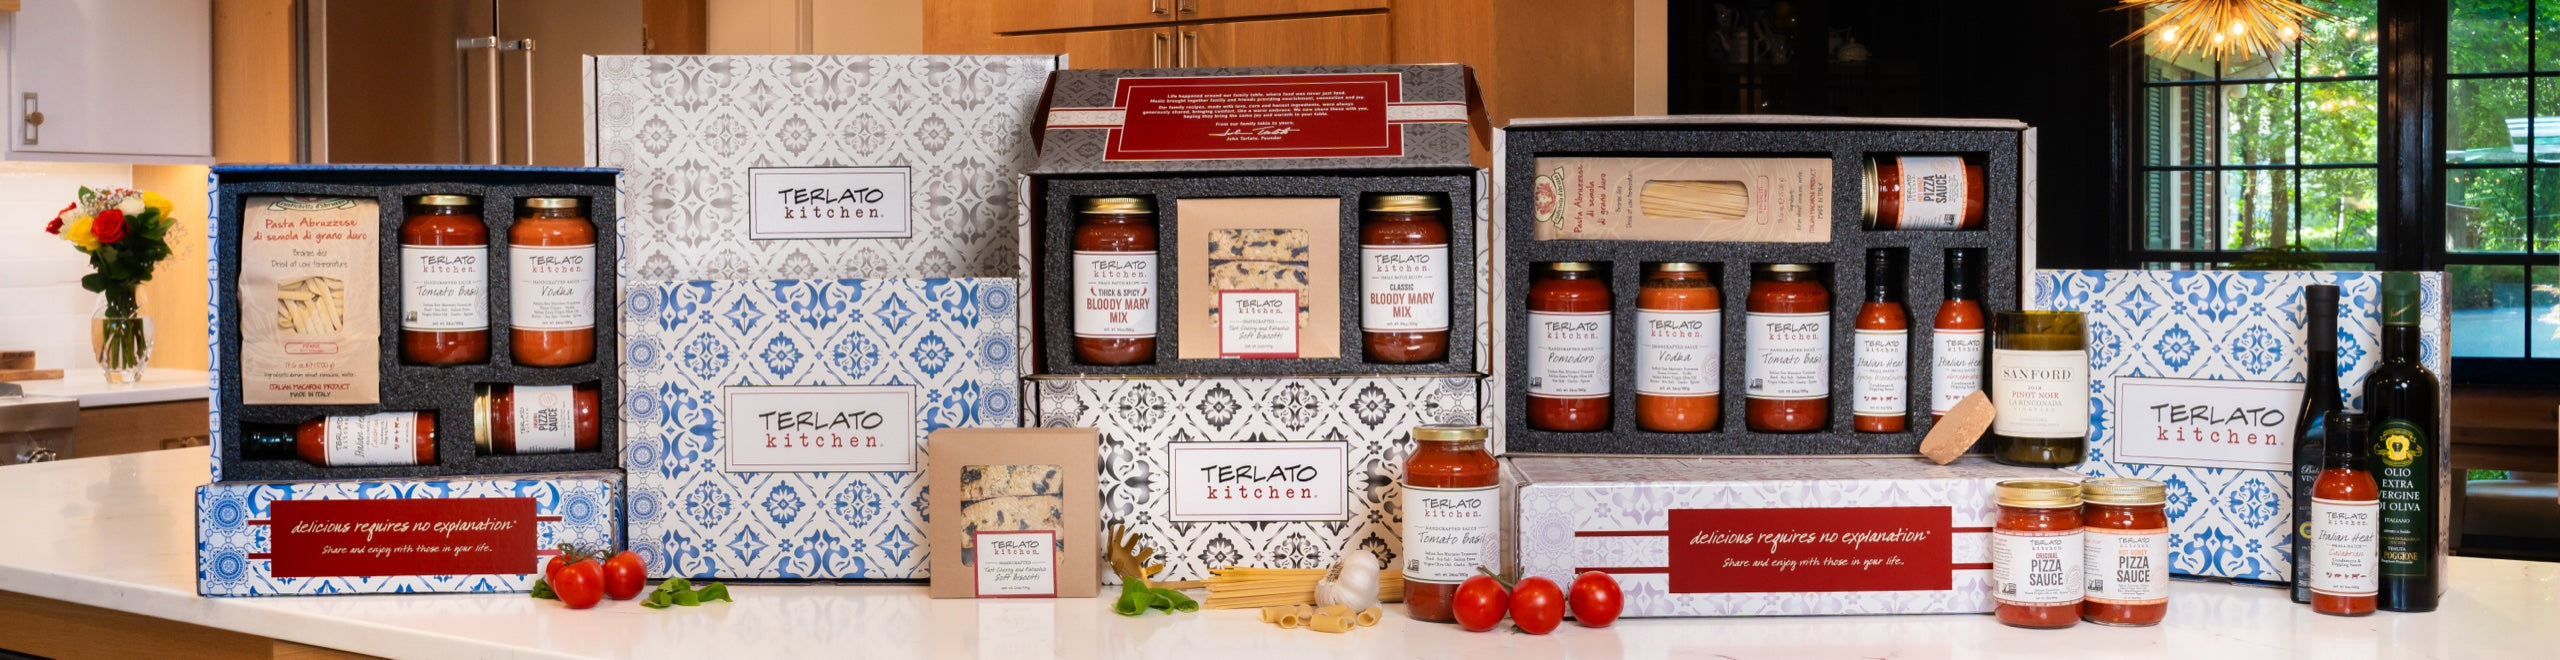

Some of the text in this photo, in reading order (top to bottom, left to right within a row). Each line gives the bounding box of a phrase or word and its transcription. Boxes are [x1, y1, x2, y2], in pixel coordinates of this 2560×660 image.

[1597, 173, 1606, 190] duro
[1586, 181, 1594, 207] semola
[1923, 175, 1935, 202] PIZZA
[1936, 174, 1947, 204] SAUCE
[778, 187, 884, 205] TERLATO
[1574, 164, 1583, 233] Pasta Abruzzese
[1598, 194, 1608, 215] grano
[265, 217, 357, 229] Pasta Abruzzese
[253, 229, 367, 243] di semola di grano duro
[420, 256, 476, 265] TERLATO
[529, 256, 583, 265] TERLATO
[1091, 260, 1146, 270] TERLATO
[1374, 254, 1430, 264] TERLATO
[416, 285, 480, 296] Tomato Basil
[541, 285, 574, 297] Vodka
[1098, 288, 1115, 296] THICK
[1123, 288, 1140, 297] SPICY
[1087, 298, 1150, 310] BLOODY MARY
[1236, 299, 1283, 308] TERLATO
[1370, 292, 1434, 305] BLOODY MARY
[1110, 312, 1128, 324] MIX
[1393, 306, 1412, 318] MIX
[1545, 321, 1598, 332] TERLATO
[1649, 319, 1702, 330] TERLATO
[1767, 323, 1819, 333] TERLATO
[1239, 332, 1254, 340] Soft
[1548, 352, 1595, 364] Pomodoro
[1659, 351, 1692, 362] Vodka
[1762, 353, 1800, 364] Tomato
[1857, 357, 1904, 367] Italian Heat
[1938, 357, 1983, 367] Italian Hea
[2003, 369, 2071, 380] SANFORD
[2012, 390, 2036, 398] PINOT
[538, 409, 547, 430] PIZZA
[549, 408, 558, 432] SAUCE
[759, 410, 883, 431] TERLATO
[2150, 403, 2284, 427] TERLATO
[1201, 464, 1317, 484] TERLATO
[2384, 467, 2411, 477] OLIO
[2382, 479, 2414, 489] EXTRA
[1422, 498, 1481, 509] TERLATO
[2389, 502, 2420, 512] OLIVA
[2326, 512, 2368, 520] TERLATO
[291, 520, 351, 534] delicious
[354, 519, 410, 542] requires
[412, 521, 430, 532] no
[2318, 530, 2349, 541] Italian
[2351, 531, 2374, 542] Heat
[1418, 531, 1486, 544] Tomato Basil
[1690, 530, 1754, 545] delicious
[1757, 530, 1816, 553] requires
[1819, 531, 1838, 544] no
[322, 545, 347, 554] Share
[350, 545, 366, 554] and
[367, 545, 392, 558] enjoy
[394, 544, 413, 553] with
[416, 544, 440, 553] those
[454, 546, 473, 557] your
[475, 542, 493, 552] life.
[992, 540, 1040, 549] TERLATO
[2383, 551, 2418, 560] POGGIONE
[1722, 555, 1905, 571] Share and enjoy with those in your life.
[2031, 559, 2062, 572] PIZZA
[2120, 556, 2149, 569] PIZZA
[995, 573, 1040, 582] Soft Biscotti
[2029, 573, 2064, 586] SAUCE
[2116, 570, 2150, 583] SAUCE
